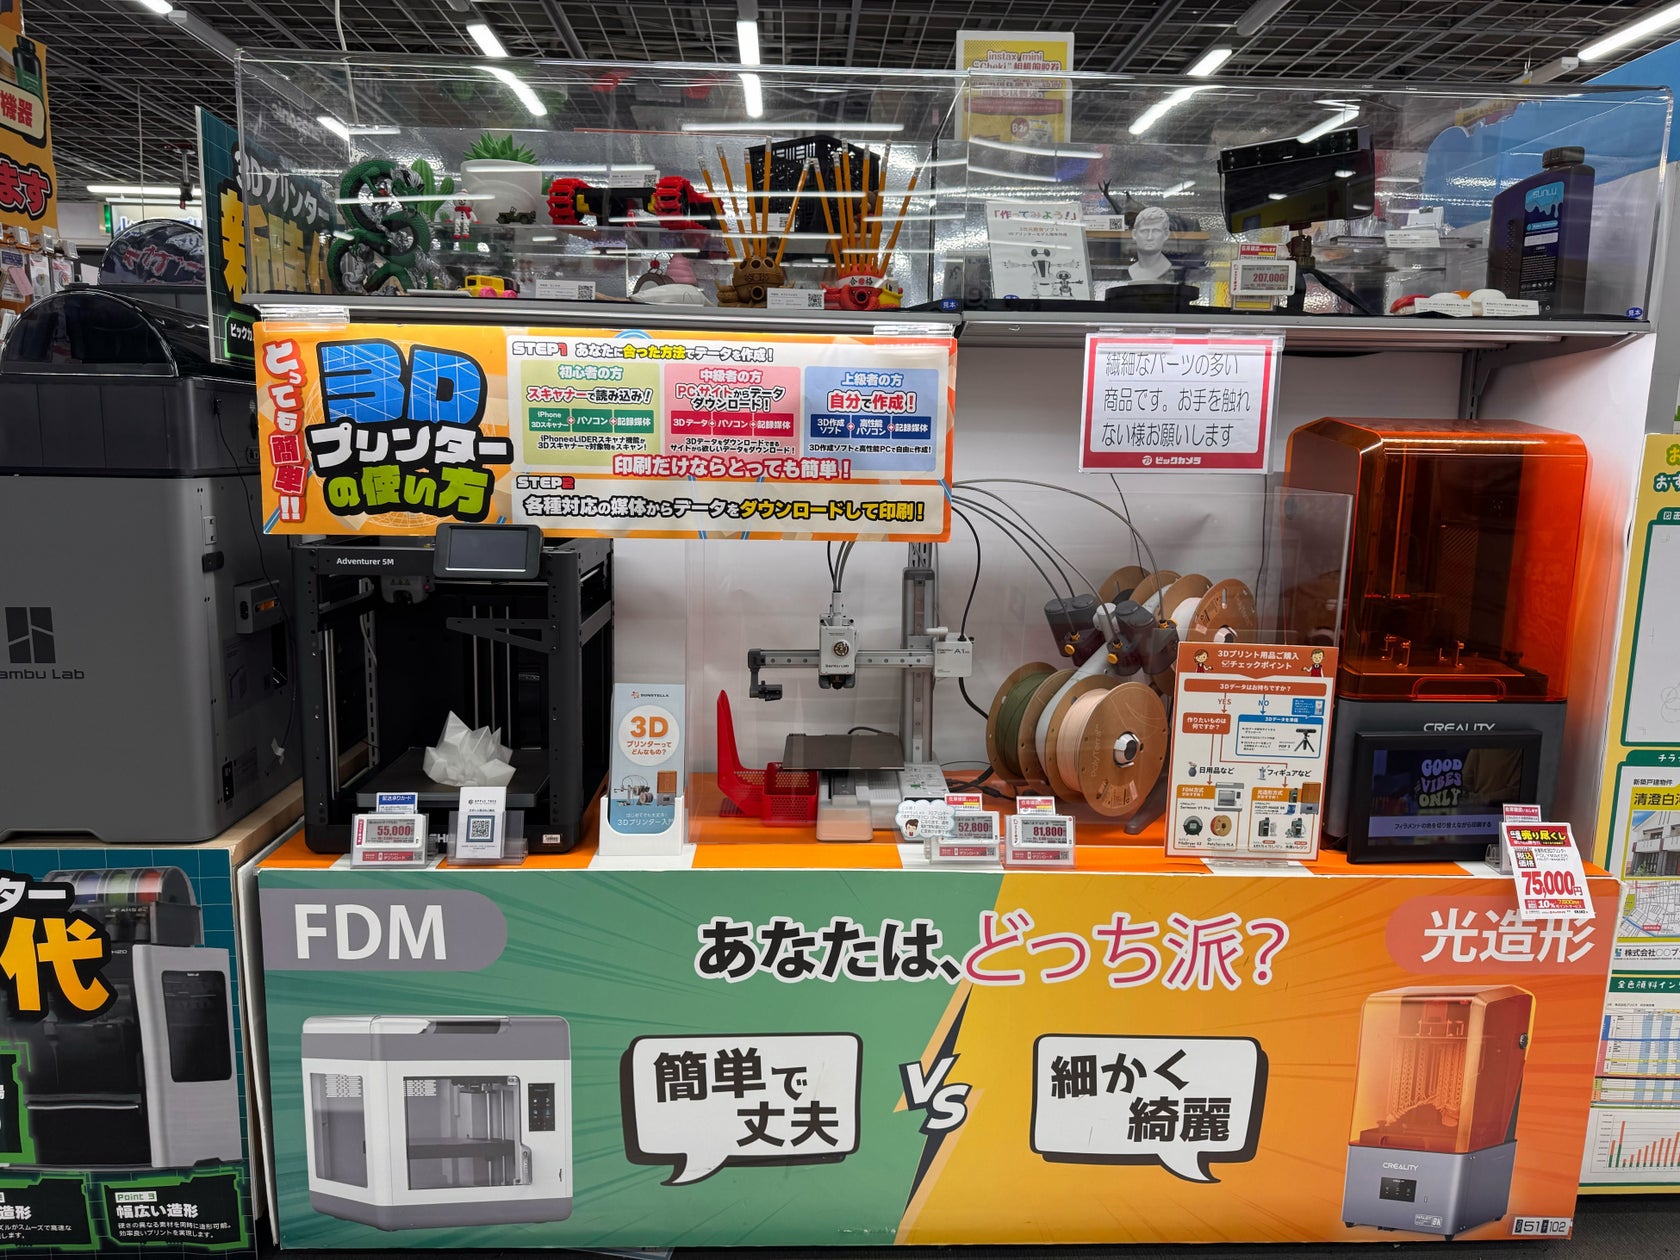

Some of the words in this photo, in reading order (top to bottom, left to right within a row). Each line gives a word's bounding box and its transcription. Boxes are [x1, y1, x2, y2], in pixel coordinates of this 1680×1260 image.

[987, 51, 1018, 60] instax
[1021, 51, 1043, 60] mini
[0, 92, 33, 128] 機器
[234, 150, 330, 225] 3Dプリンター
[1532, 188, 1557, 199] SUNLU
[512, 341, 568, 356] STEP1
[1105, 352, 1239, 377] 繊細なパーツの多い
[558, 364, 624, 381] 初心者の方
[699, 368, 763, 384] 中級者の方
[318, 340, 484, 423] 3D
[841, 372, 904, 388] 上級者の方
[676, 383, 786, 400] PCサイトからデータ
[828, 390, 917, 413] 自分で作成！
[1103, 387, 1251, 413] 商品です。お手を触れ
[537, 410, 562, 419] iPhone
[577, 416, 609, 426] パソコン
[531, 420, 569, 428] 3Dスキャナー
[617, 417, 651, 427] 記録媒体
[673, 418, 708, 428] 3Dデータ
[717, 420, 749, 429] パソコン
[757, 421, 791, 430] 記録媒体
[817, 418, 845, 427] 3D作成
[859, 419, 883, 428] 高性能
[895, 423, 929, 433] 記録媒体
[820, 427, 842, 435] ソフト
[856, 427, 886, 436] パソコン
[1101, 422, 1235, 448] ない様お願いします
[309, 421, 508, 469] プリンター
[612, 454, 851, 479] 印刷だけならとっても簡単！
[1155, 456, 1202, 465] ビックカメラ
[327, 464, 489, 513] の使い方
[516, 476, 576, 490] STEP2
[522, 495, 927, 521] 各種対応の媒体からデータをダウンロードして印刷！
[336, 557, 381, 566] Adventurer
[382, 558, 395, 566] 5M
[1217, 649, 1300, 660] 3Dプリント用品ご購入
[1231, 660, 1293, 670] チェックポイント
[52, 669, 85, 680] Lab
[1217, 698, 1232, 706] YES
[1258, 699, 1270, 707] NO
[630, 715, 669, 738] 3D
[626, 740, 672, 749] プリンターって
[1199, 766, 1235, 775] 日用品など
[1267, 769, 1312, 778] フィギュアなど
[1421, 758, 1463, 777] GOOD
[1421, 771, 1462, 793] VIBES
[1418, 787, 1461, 807] ONLY
[1634, 793, 1680, 806] 清澄白
[377, 825, 411, 837] 55,000
[1516, 852, 1533, 860] 税込
[294, 903, 447, 961] FDM
[1420, 907, 1596, 963] 光造形
[0, 916, 110, 1011] 代
[1617, 979, 1680, 989] 全色顔料イン
[652, 1047, 808, 1103] 簡単で
[1049, 1048, 1190, 1100] 細かく
[900, 1054, 974, 1135] VS
[736, 1100, 840, 1148] 丈夫
[1126, 1095, 1232, 1144] 綺麗
[1382, 1161, 1419, 1171] CREALITY
[117, 1193, 144, 1201] Point
[147, 1193, 155, 1201] 3
[116, 1203, 199, 1219] 幅広い造形
[1549, 1221, 1566, 1233] 102
